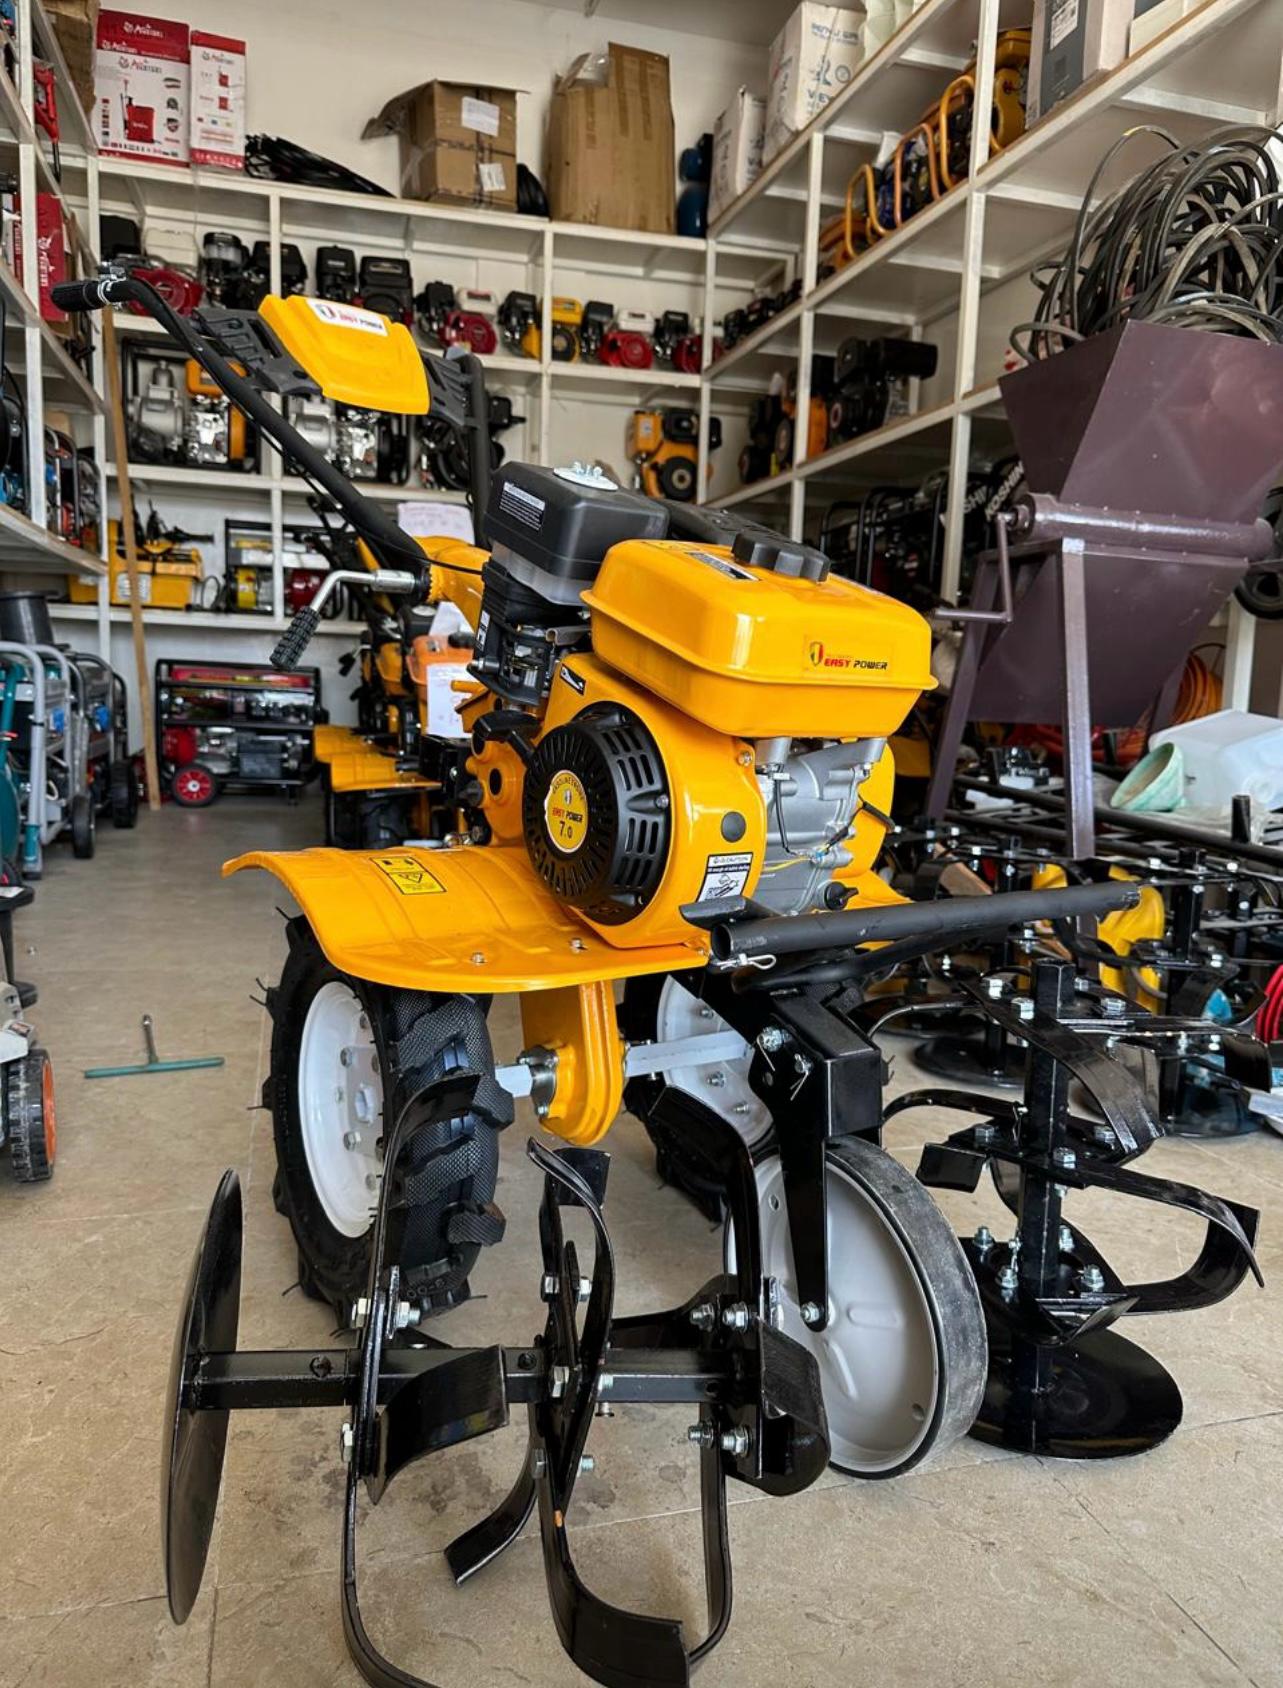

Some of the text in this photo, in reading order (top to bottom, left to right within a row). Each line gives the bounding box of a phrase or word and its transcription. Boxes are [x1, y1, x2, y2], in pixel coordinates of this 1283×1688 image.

[984, 460, 1024, 522] KOSHIN
[853, 660, 888, 670] POWER
[566, 810, 583, 823] POWER
[559, 820, 573, 839] 7.0
